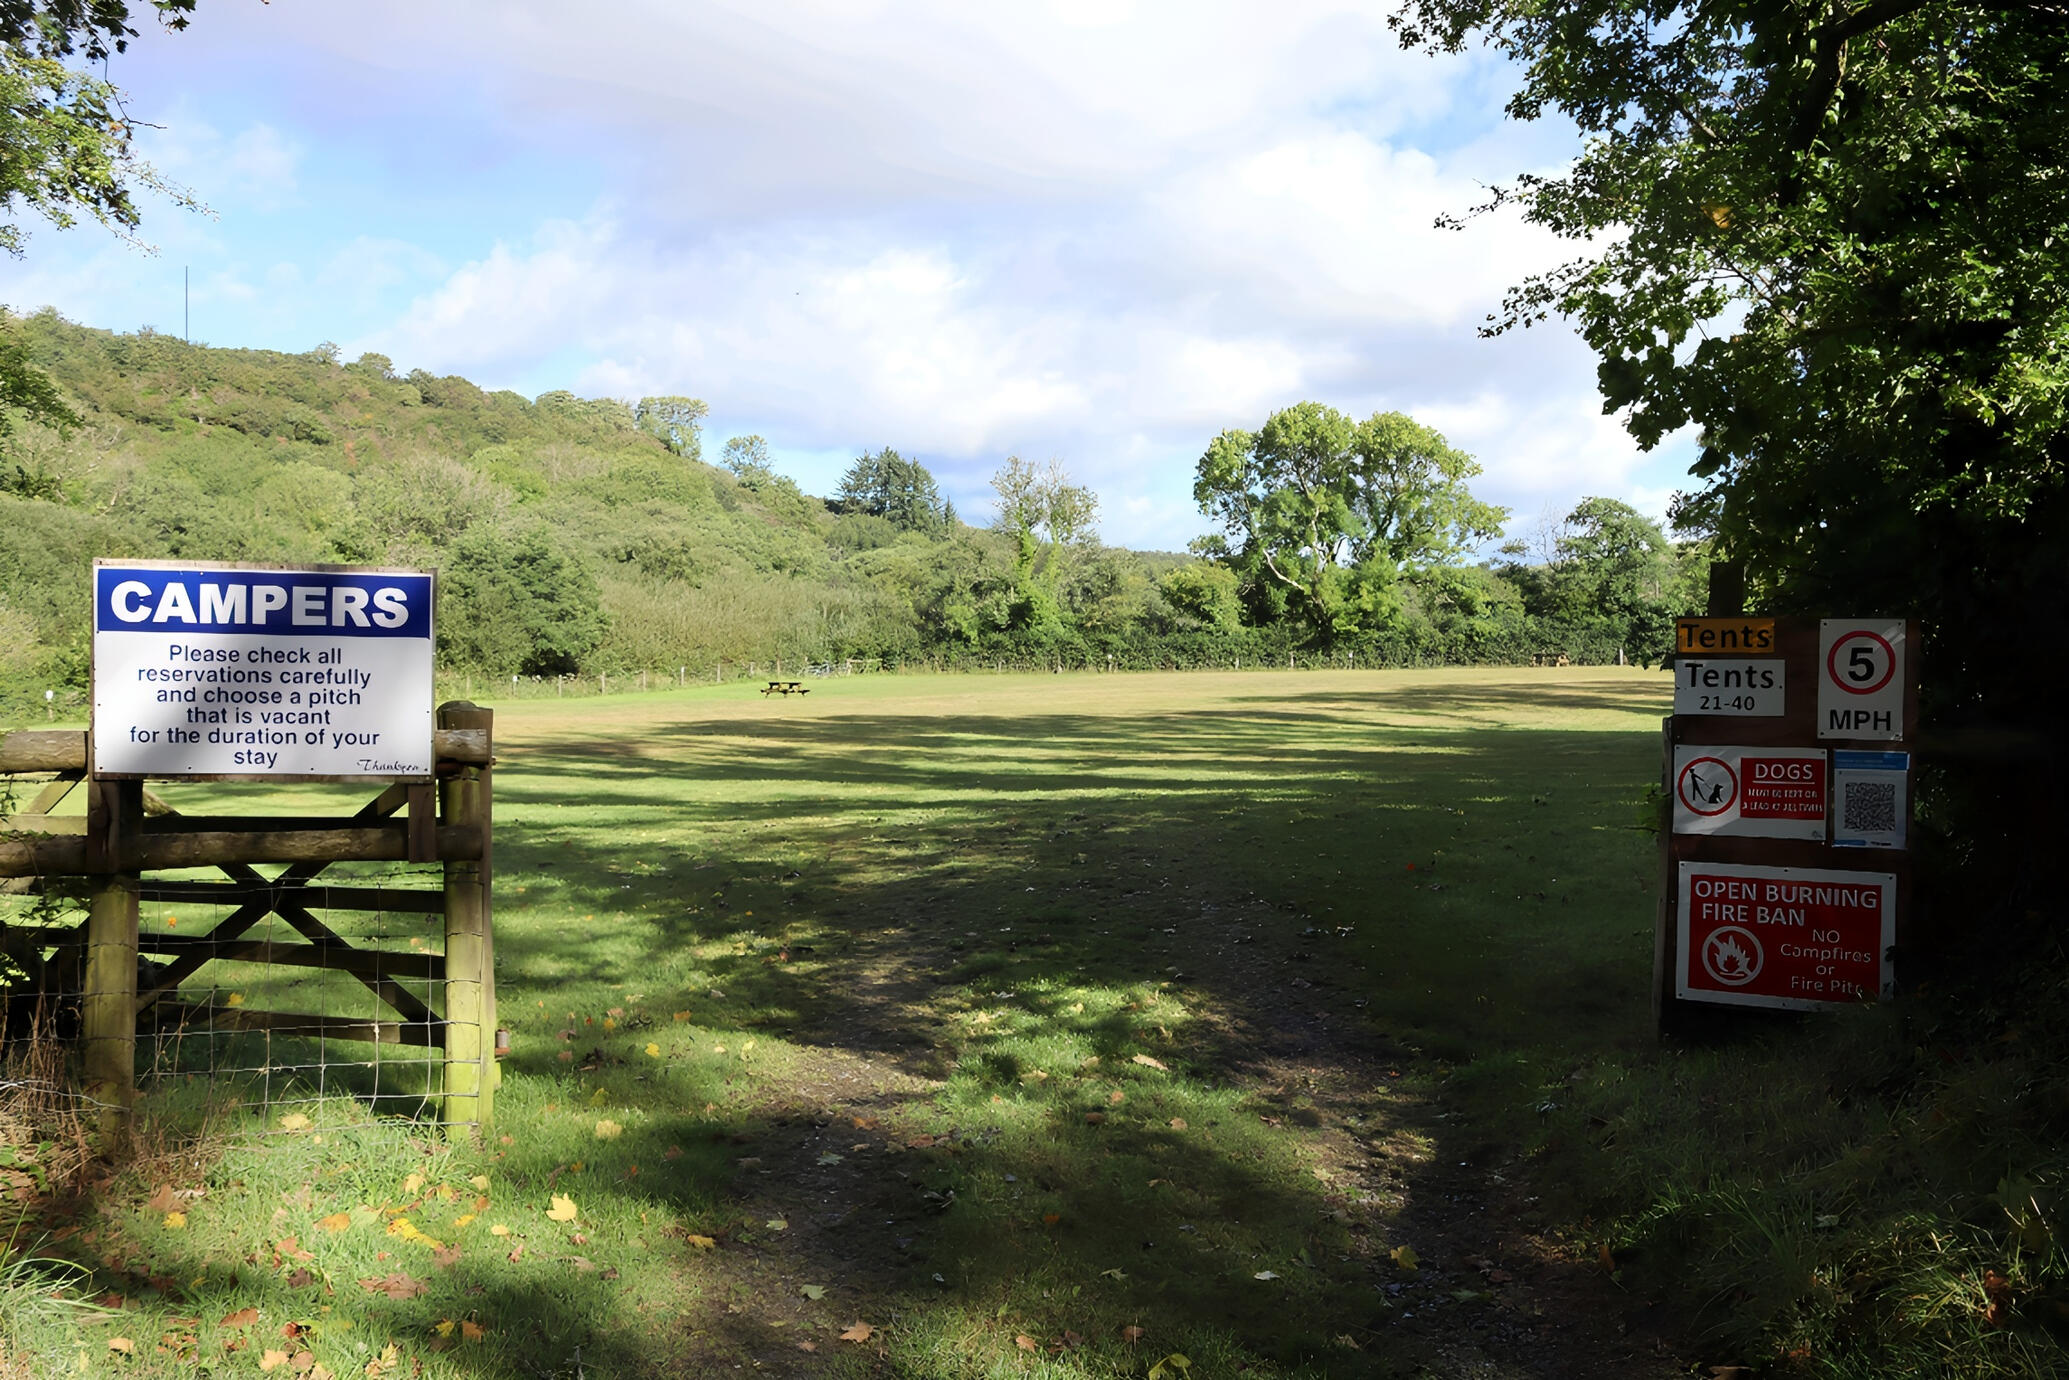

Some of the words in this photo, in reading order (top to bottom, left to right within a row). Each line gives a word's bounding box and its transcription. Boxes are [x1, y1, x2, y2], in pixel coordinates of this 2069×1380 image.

[110, 580, 410, 629] CAMPERS
[1681, 623, 1771, 649] Tents
[169, 645, 240, 663] Please
[247, 647, 311, 664] check
[318, 648, 342, 664] all
[1848, 647, 1875, 682] 5
[138, 665, 272, 684] reservations
[280, 667, 371, 690] carefully
[1685, 662, 1774, 689] Tents
[157, 687, 197, 703] and
[203, 687, 283, 704] choose
[290, 691, 301, 705] a
[309, 689, 361, 709] pitch
[1699, 695, 1756, 711] 21-40
[186, 707, 228, 724] that
[235, 707, 253, 724] is
[260, 709, 331, 725] vacant
[1829, 709, 1892, 731] MPH
[130, 727, 160, 744] for
[167, 727, 201, 744] the
[208, 728, 297, 746] duration
[305, 729, 326, 746] of
[333, 732, 381, 750] your
[234, 749, 278, 769] stay
[1755, 763, 1814, 780] DOGS
[1694, 880, 1757, 901] OPEN
[1765, 884, 1878, 909] BURNING
[1702, 903, 1749, 922] FIRE
[1756, 906, 1805, 927] BAN
[1812, 928, 1841, 944] NO
[1780, 943, 1872, 963] Campfires
[1815, 965, 1836, 976] or
[1791, 975, 1824, 992] Fire
